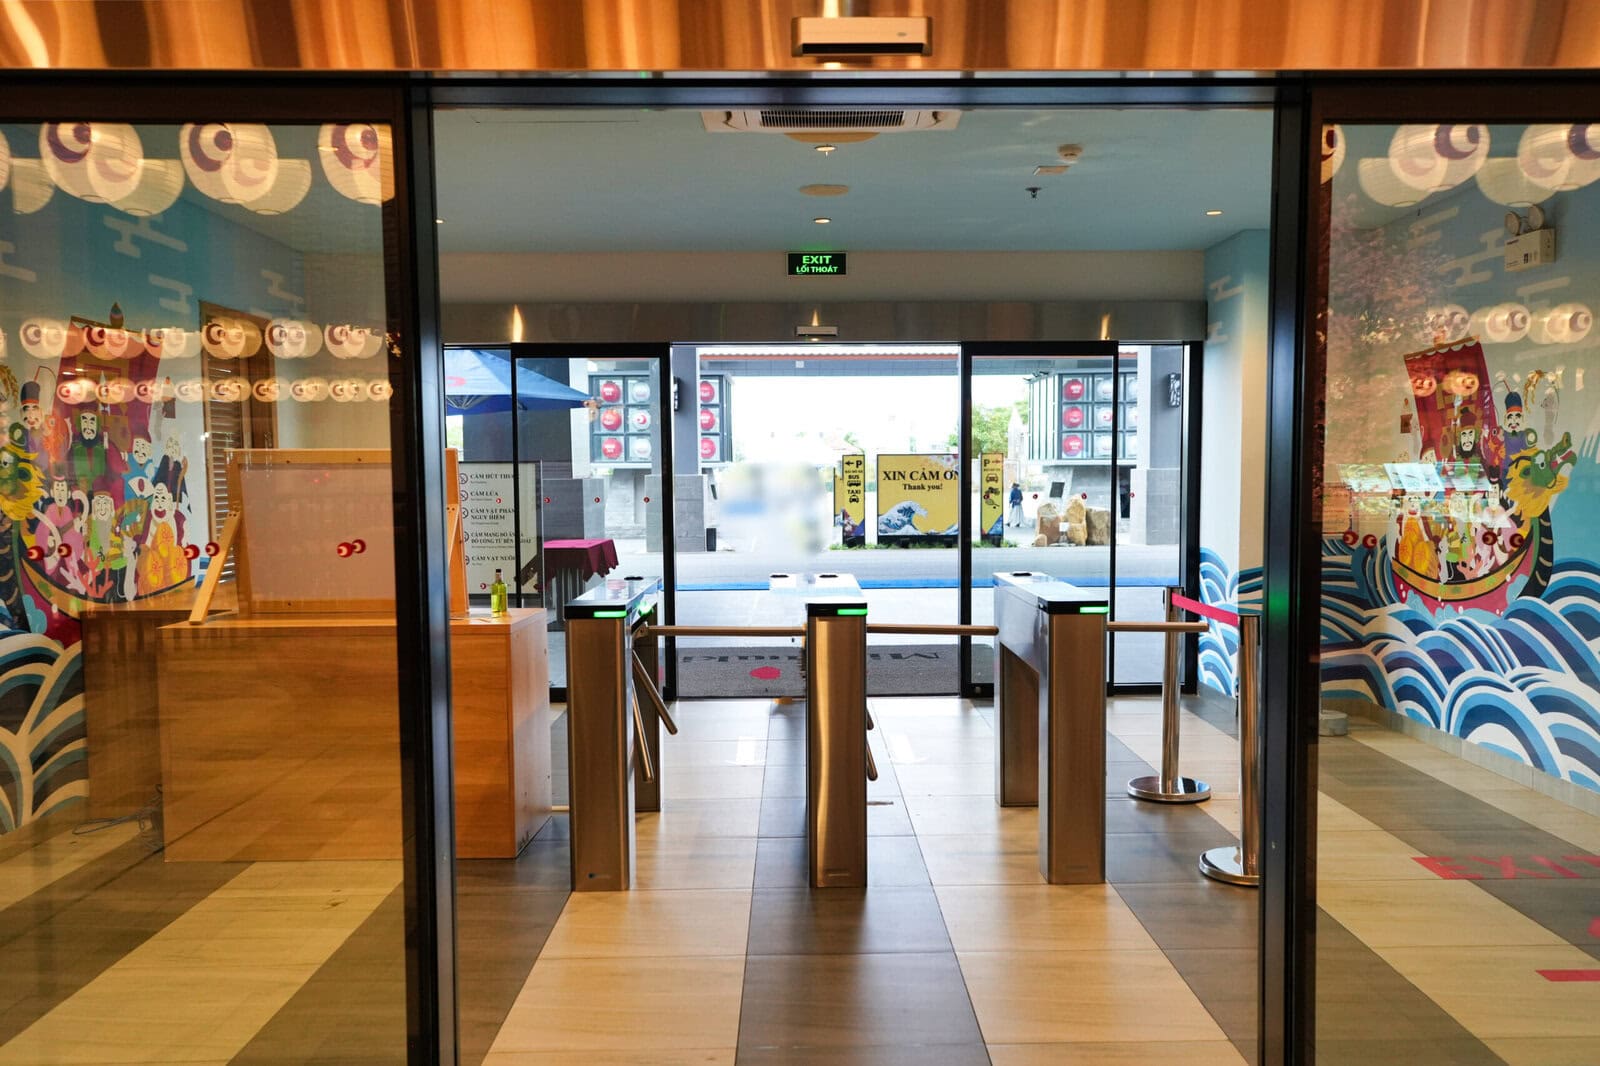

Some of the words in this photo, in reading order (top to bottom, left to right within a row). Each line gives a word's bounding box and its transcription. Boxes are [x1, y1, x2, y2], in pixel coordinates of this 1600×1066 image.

[802, 255, 832, 264] EXIT
[796, 264, 810, 273] LỐI
[810, 265, 839, 273] THOÁT
[855, 459, 863, 469] P
[883, 470, 906, 481] XIN
[909, 467, 939, 481] CẢM
[902, 483, 925, 491] Thank
[925, 483, 943, 492] you!
